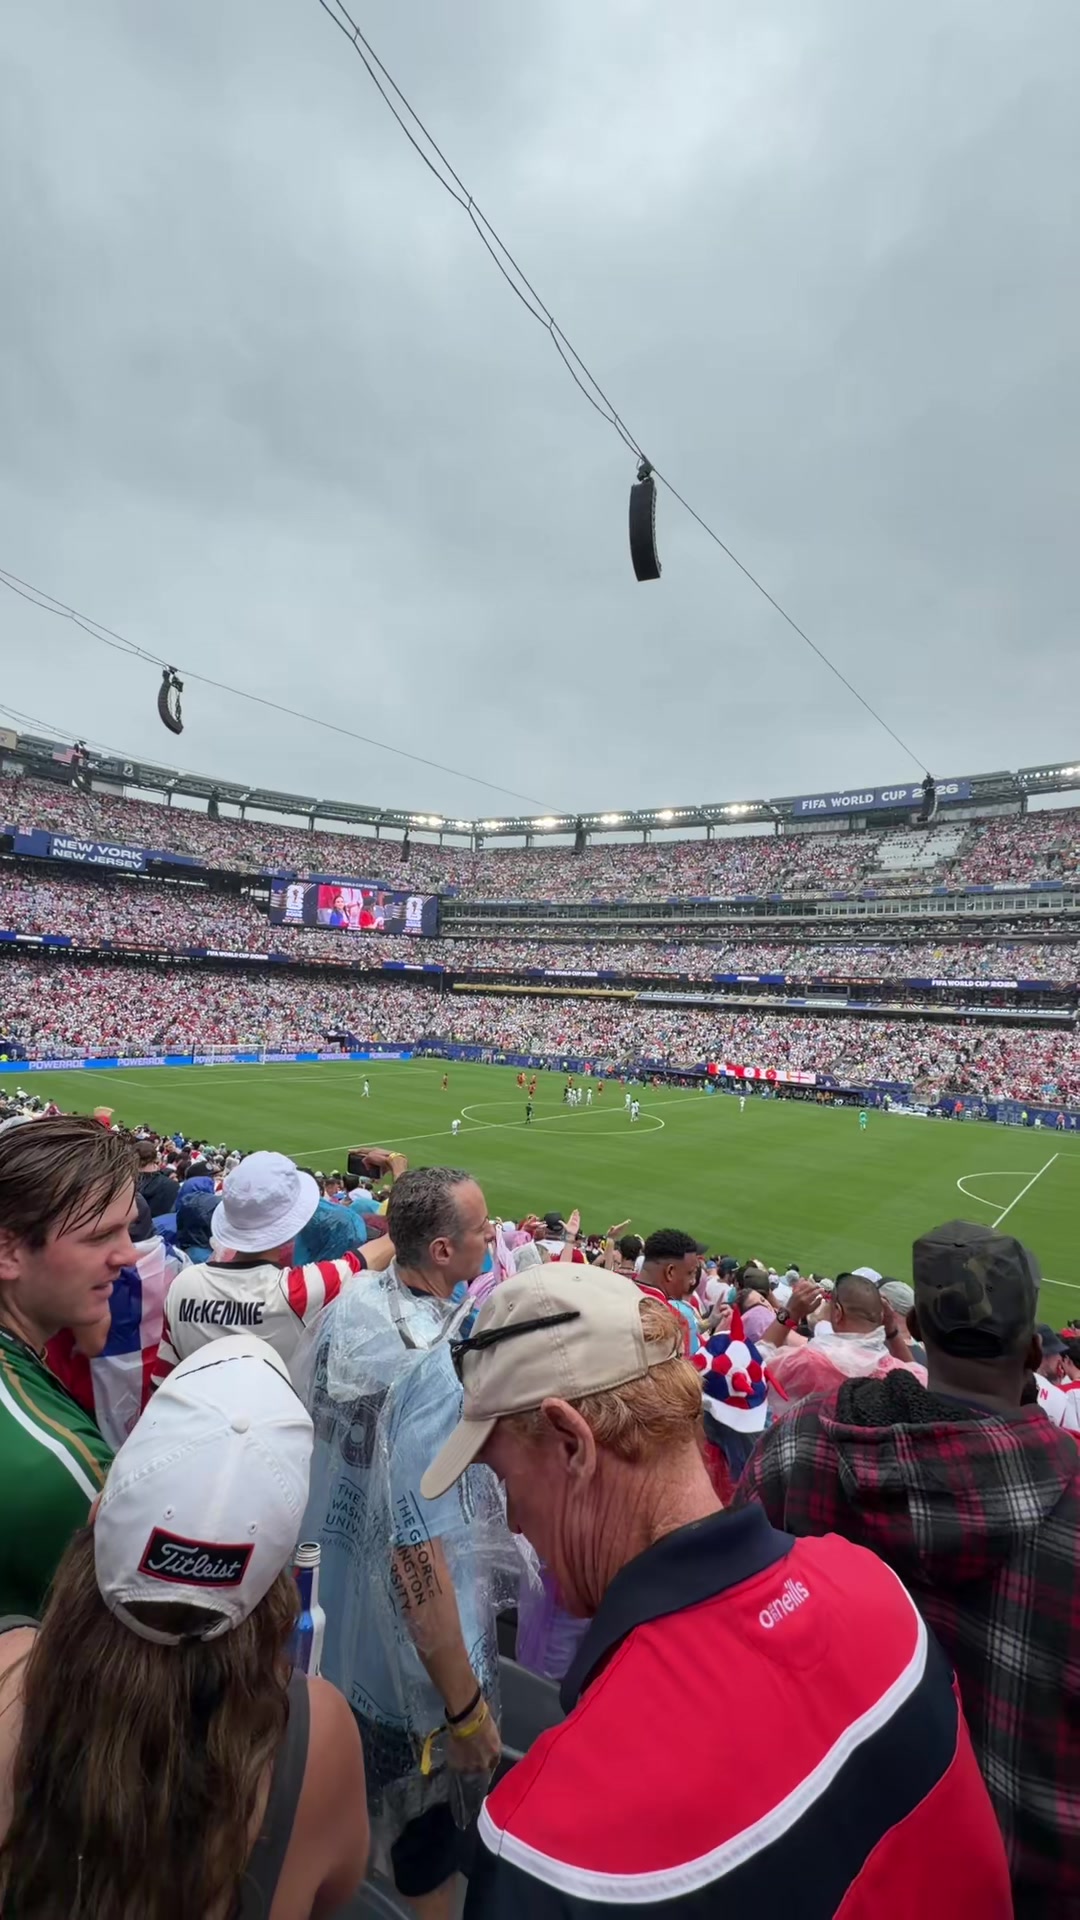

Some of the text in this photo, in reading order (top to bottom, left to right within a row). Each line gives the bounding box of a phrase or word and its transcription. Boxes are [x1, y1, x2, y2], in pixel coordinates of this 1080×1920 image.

[801, 783, 959, 810] FIFA WORLD CUP 226
[52, 848, 142, 869] NEW JERSEY
[53, 838, 143, 861] NEW YORK
[29, 1060, 86, 1070] POWERADE
[179, 1298, 265, 1326] McKENNIE
[338, 1483, 361, 1505] THE
[396, 1494, 416, 1529] THE
[148, 1543, 242, 1578] Titleist
